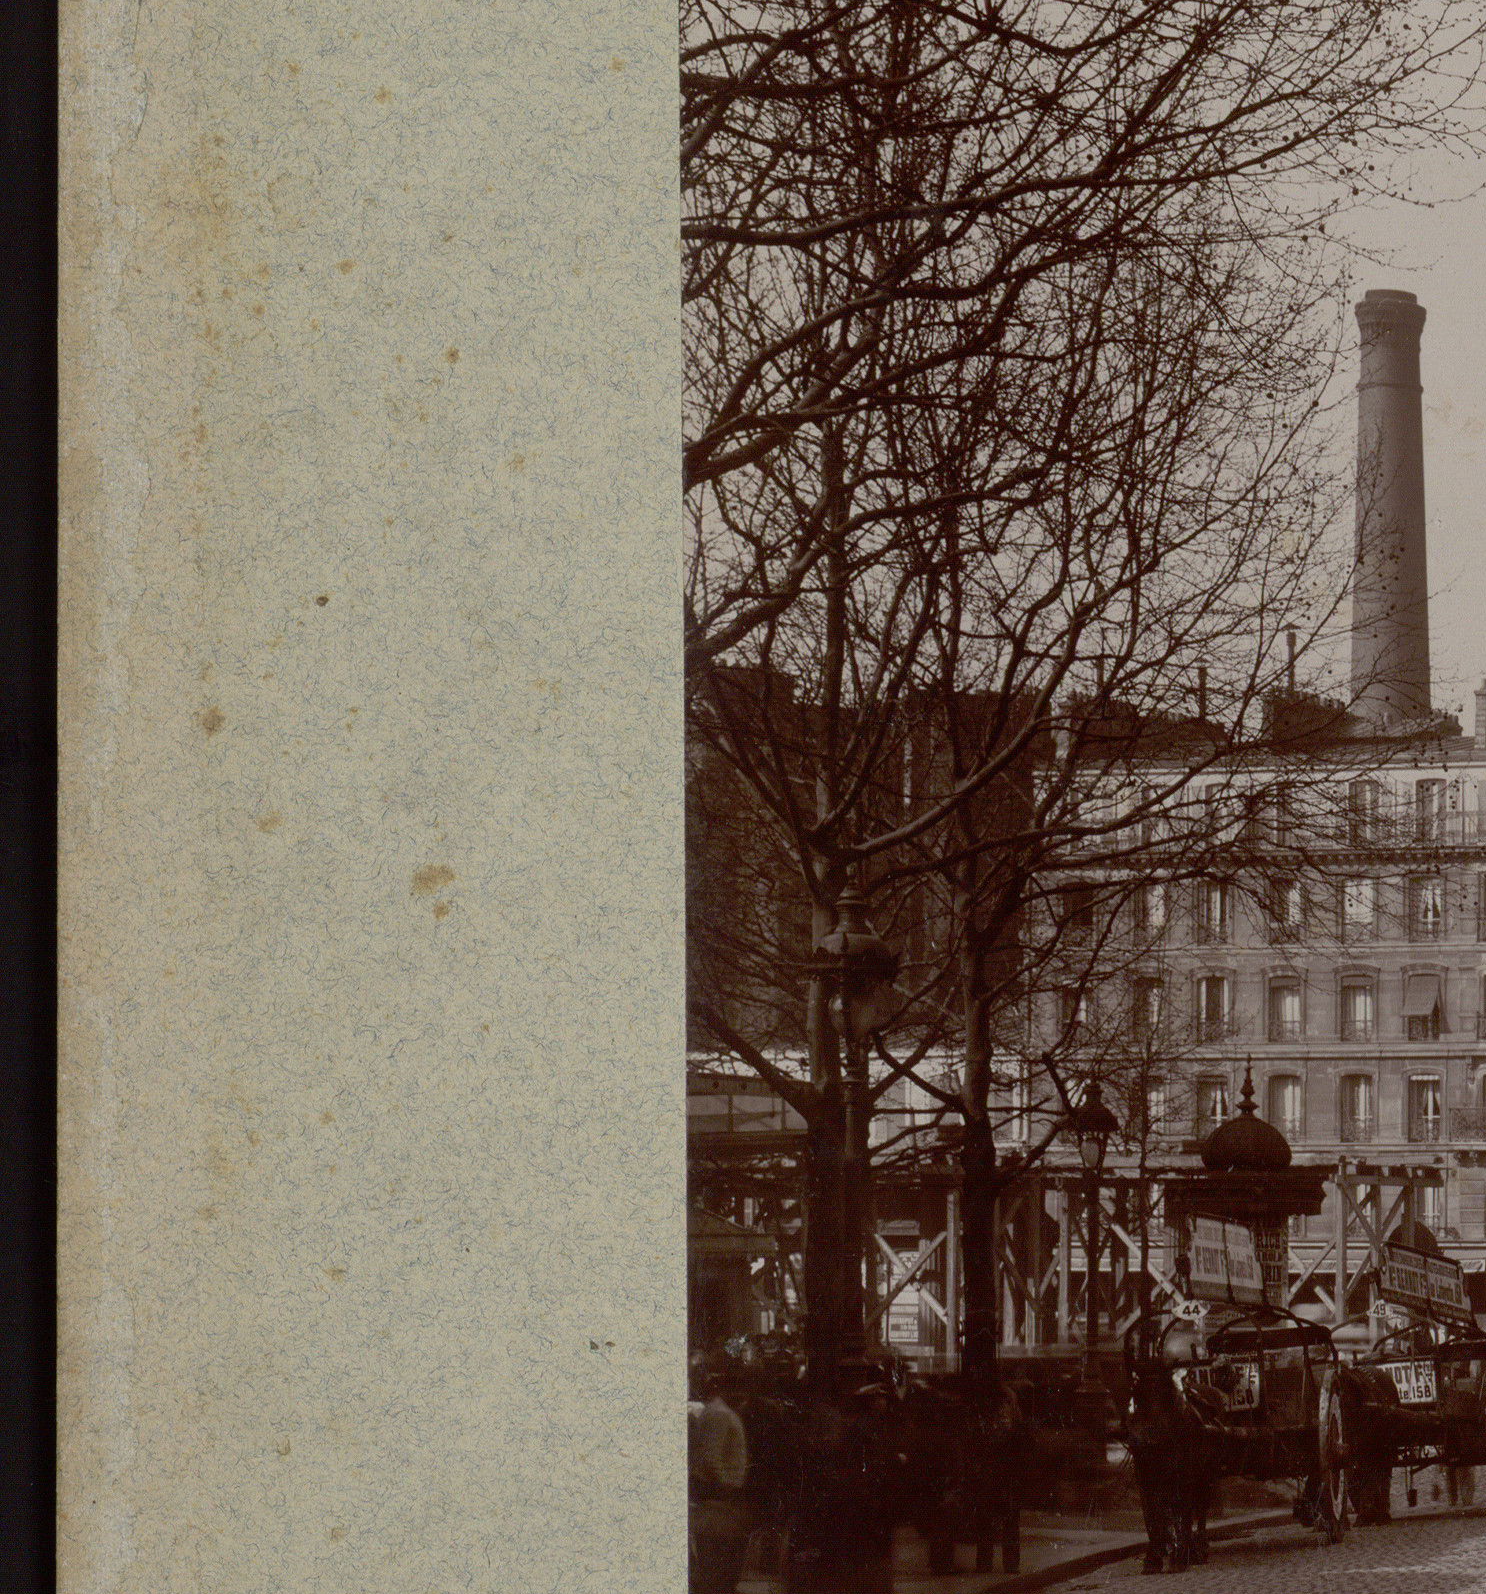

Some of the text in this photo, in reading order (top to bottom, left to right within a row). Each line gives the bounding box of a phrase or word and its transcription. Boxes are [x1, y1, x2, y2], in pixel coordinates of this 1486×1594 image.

[1182, 1305, 1200, 1316] 44
[1373, 1303, 1387, 1316] 49
[1412, 1385, 1431, 1399] 158
